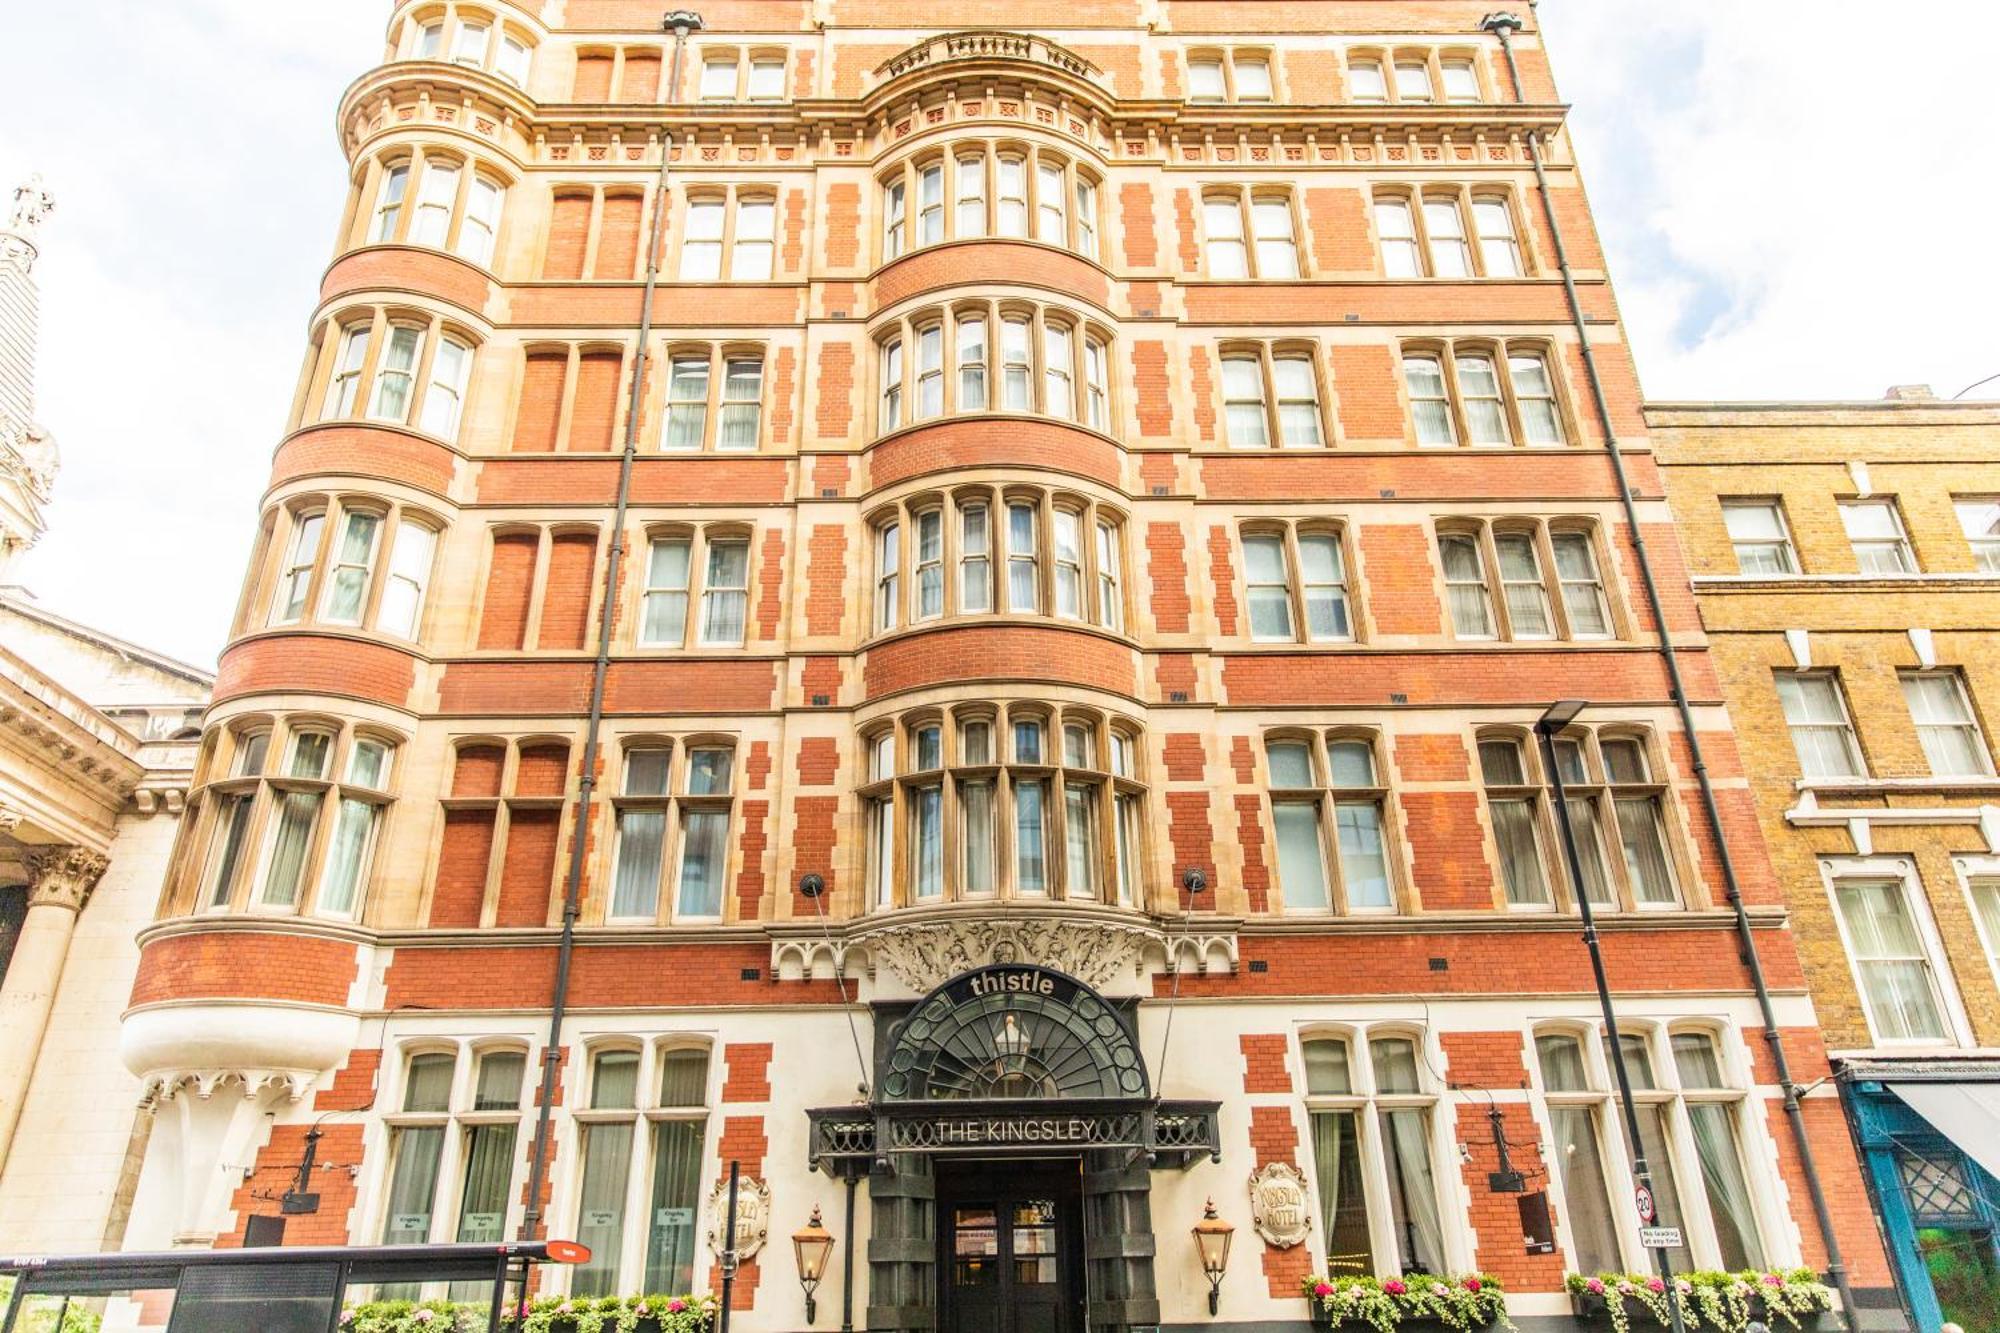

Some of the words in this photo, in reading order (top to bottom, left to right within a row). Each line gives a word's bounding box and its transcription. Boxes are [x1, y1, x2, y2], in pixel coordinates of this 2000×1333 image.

[970, 970, 1054, 996] thistle
[936, 1121, 980, 1142] THE
[987, 1119, 1096, 1142] KINGSLEY
[1638, 1197, 1649, 1211] 20
[1267, 1208, 1300, 1226] HOTEL
